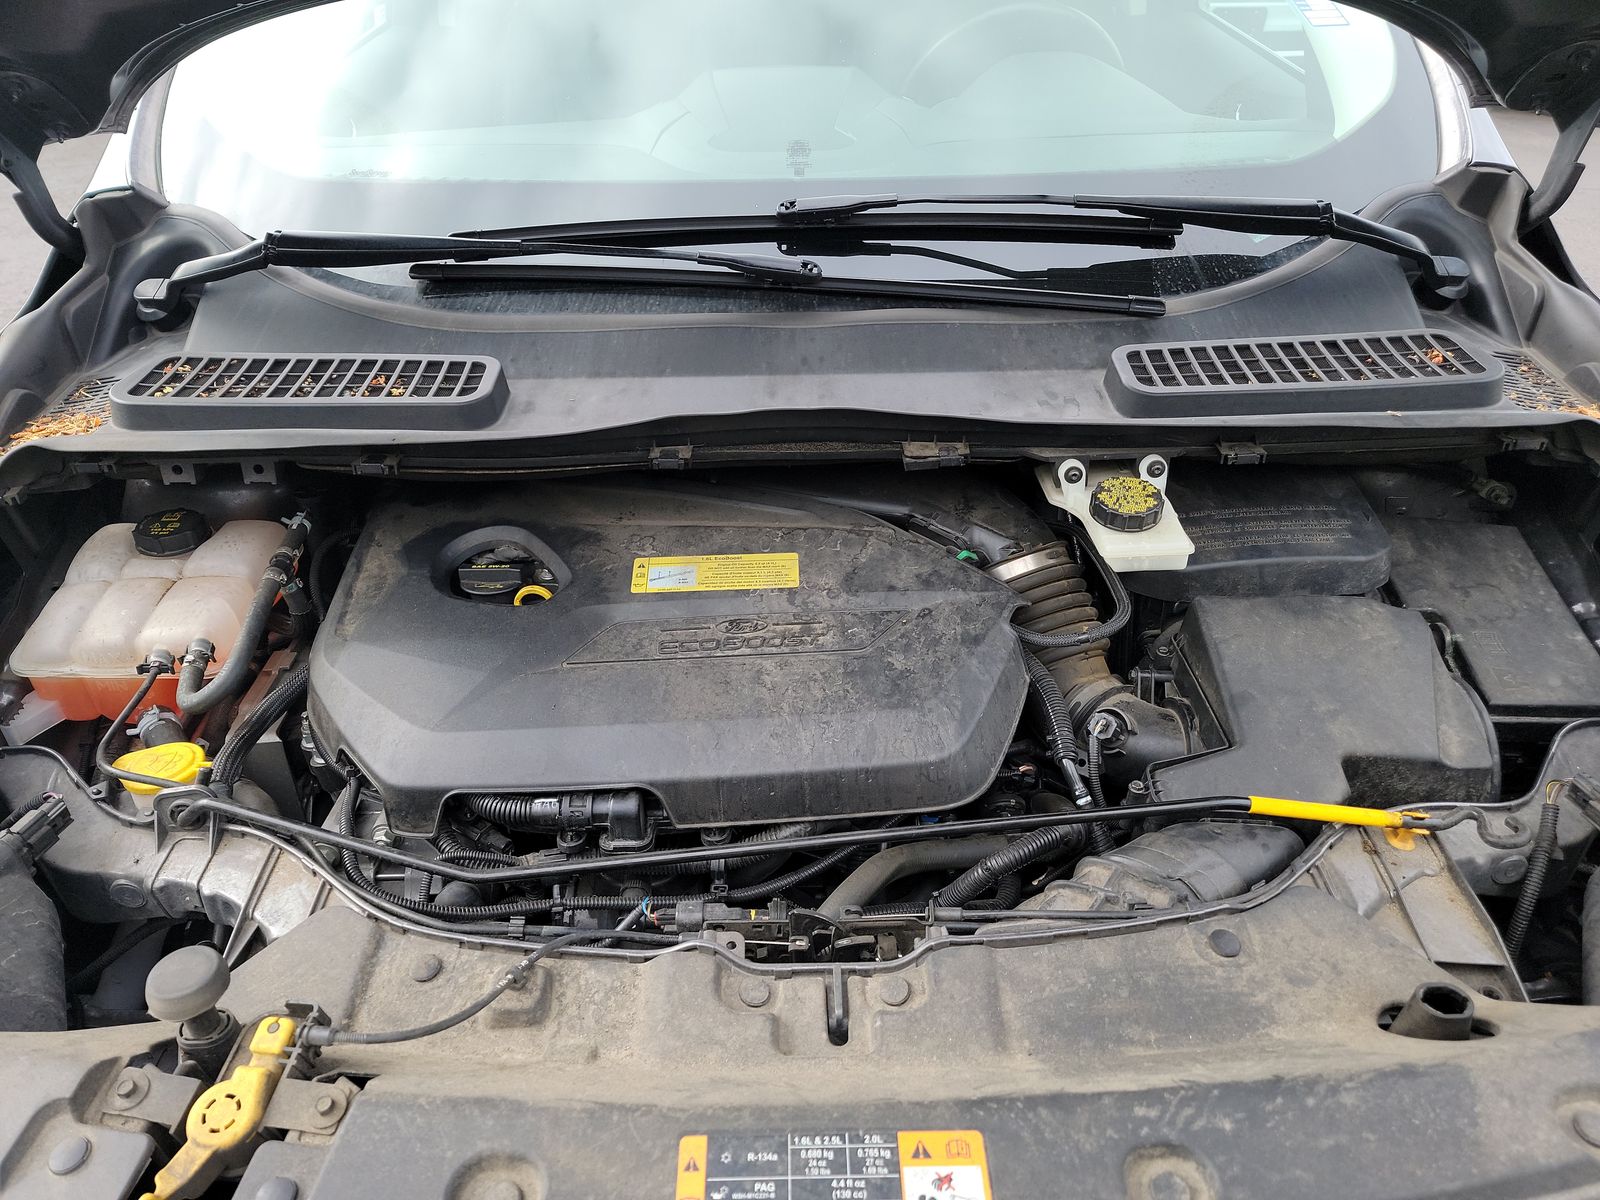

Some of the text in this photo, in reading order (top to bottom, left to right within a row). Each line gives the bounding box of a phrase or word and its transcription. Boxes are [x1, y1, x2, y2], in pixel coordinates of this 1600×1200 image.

[793, 1135, 843, 1145] 1.6L & 2.5L
[863, 1134, 884, 1144] 2.0L
[747, 1152, 779, 1162] R-134a
[823, 1149, 835, 1160] kg
[880, 1148, 891, 1159] kg
[754, 1181, 776, 1192] PAG
[831, 1179, 845, 1188] 4.4
[854, 1180, 866, 1188] oz
